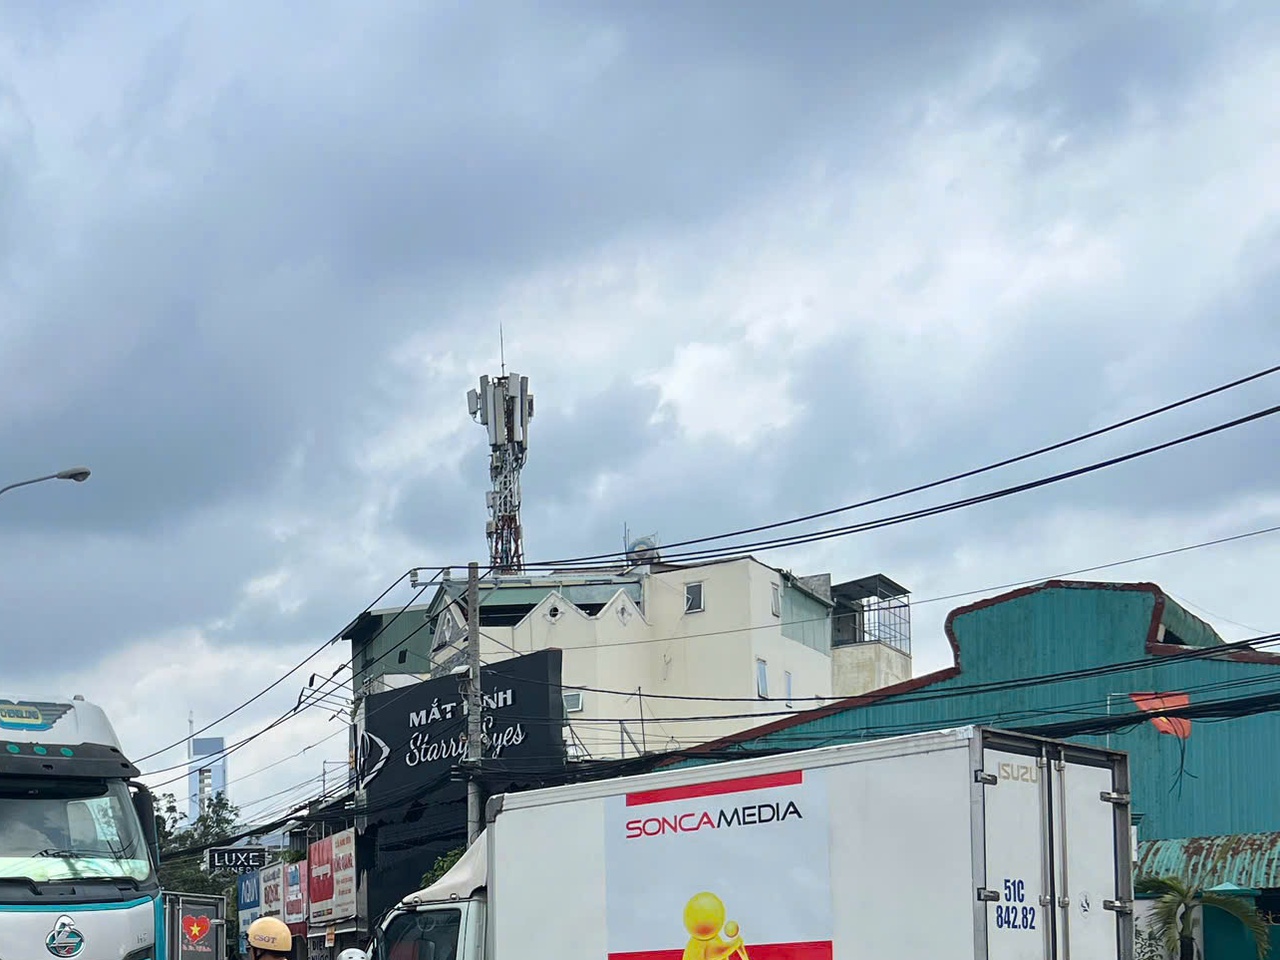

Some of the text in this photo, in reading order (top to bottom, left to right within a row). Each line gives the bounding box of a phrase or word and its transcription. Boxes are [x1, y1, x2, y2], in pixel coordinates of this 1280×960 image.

[998, 762, 1039, 783] ISUZU
[626, 800, 803, 839] SONCAMEDIA
[214, 852, 260, 866] LUXE
[1003, 879, 1025, 903] 51C
[995, 905, 1036, 930] 842.82
[253, 935, 278, 944] CSGT
